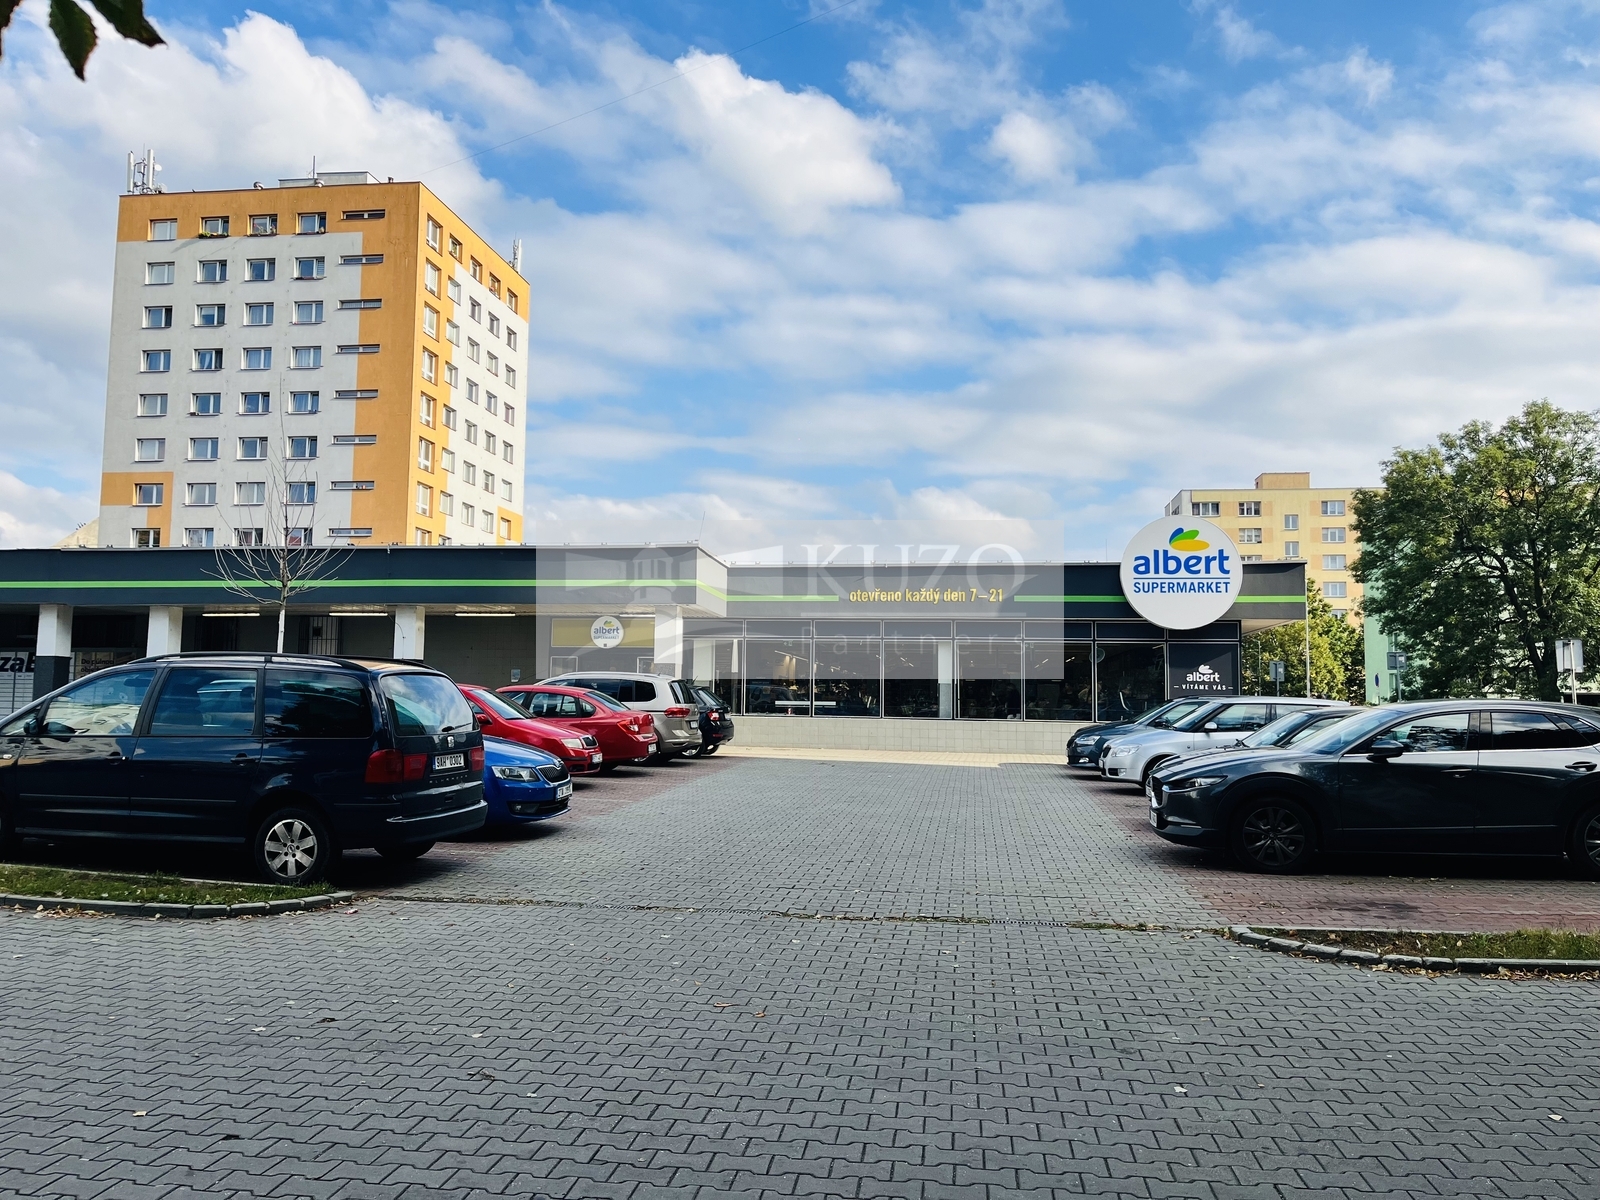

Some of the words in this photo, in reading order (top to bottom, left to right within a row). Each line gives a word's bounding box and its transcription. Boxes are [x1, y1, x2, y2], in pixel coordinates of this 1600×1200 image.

[1133, 549, 1230, 575] albert
[1133, 581, 1231, 594] SUPERMARKET
[849, 588, 902, 602] otevřeno
[905, 588, 940, 604] každý
[943, 588, 966, 602] den
[593, 627, 620, 635] albert
[1186, 672, 1220, 682] albert
